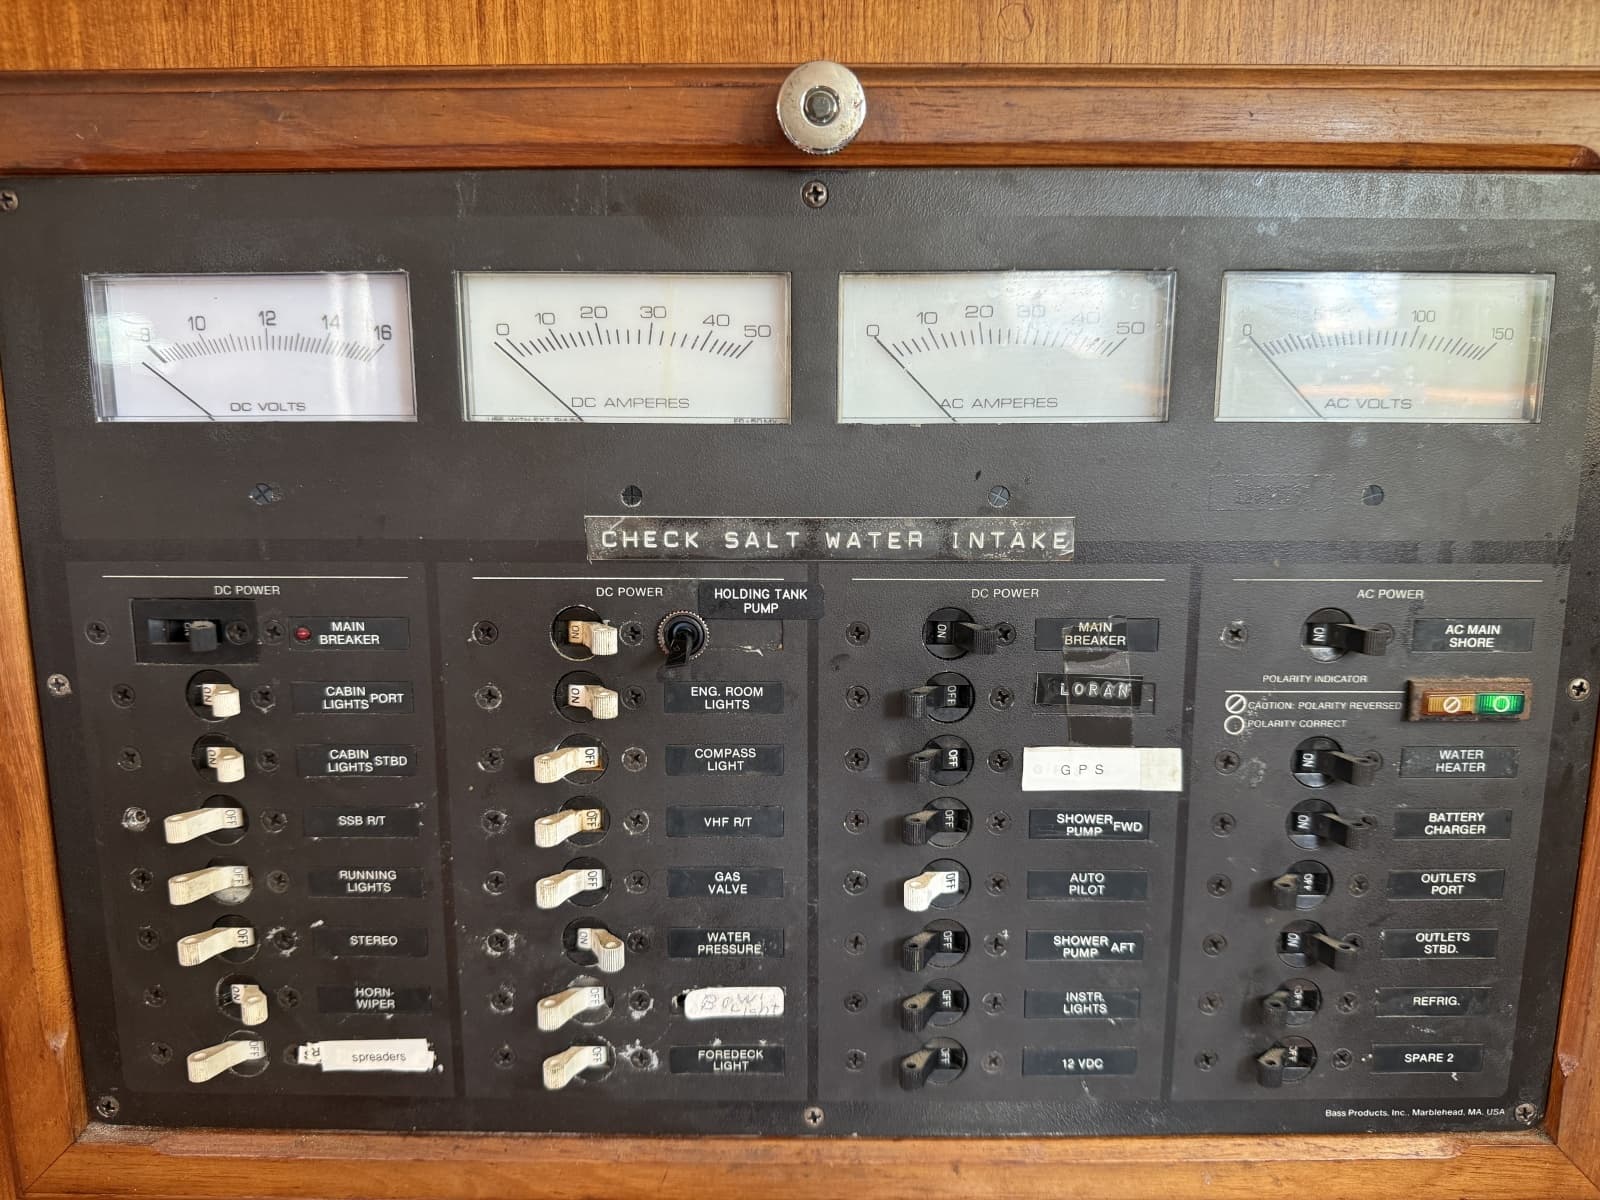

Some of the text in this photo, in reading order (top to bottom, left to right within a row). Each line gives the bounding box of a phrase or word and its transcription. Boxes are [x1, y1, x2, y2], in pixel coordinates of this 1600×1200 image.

[580, 306, 608, 319] 20
[640, 306, 667, 319] 30
[965, 305, 994, 319] 20
[1017, 304, 1046, 318] 30
[1411, 310, 1436, 323] 100
[187, 315, 206, 331] 10
[258, 310, 277, 326] 12
[322, 314, 340, 331] 14
[535, 312, 556, 325] 10
[702, 314, 730, 327] 40
[916, 311, 938, 324] 10
[1071, 311, 1101, 325] 40
[374, 324, 392, 341] 16
[496, 323, 510, 336] 0
[743, 325, 771, 338] 50
[866, 325, 880, 337] 0
[1116, 321, 1145, 335] 50
[1242, 323, 1252, 337] 0
[1491, 327, 1514, 341] 150
[230, 402, 306, 412] DC VOLTS
[571, 397, 690, 409] DC AMPERES
[940, 398, 1058, 409] AC AMPERES
[1324, 398, 1412, 409] AC VOLTS
[601, 530, 1069, 549] CHECK SALT WATER INTAKE
[214, 585, 281, 596] DC POWER
[596, 587, 663, 597] DC POWER
[714, 588, 808, 600] HOLDING TANK
[971, 588, 1039, 599] DC POWER
[1356, 589, 1424, 599] AC POWER
[744, 603, 779, 615] PUMP
[332, 622, 365, 632] MAIN
[937, 624, 947, 639] ON
[1079, 623, 1112, 633] MAIN
[1444, 625, 1501, 635] AC MAIN
[320, 635, 380, 645] BREAKER
[1313, 627, 1326, 642] ON
[1064, 635, 1126, 646] BREAKER
[1449, 638, 1495, 648] SHORE
[1262, 675, 1368, 683] POLARITY INDICATOR
[203, 687, 212, 703] ON
[326, 687, 366, 697] CABIN
[571, 687, 580, 704] ON
[691, 686, 763, 697] ENG. ROOM
[947, 685, 957, 706] OFF
[1060, 683, 1131, 698] LORAN
[370, 693, 404, 704] PORT
[323, 699, 370, 710] LIGHTS
[704, 699, 750, 710] LIGHTS
[1248, 702, 1402, 710] CAUTION: POLARITY REVERSED
[1248, 720, 1348, 728] POLARITY CORRECT
[208, 749, 217, 765] ON
[330, 750, 369, 760] CABIN
[585, 748, 596, 765] OFF
[695, 748, 756, 759] COMPASS
[948, 749, 958, 768] OFF
[1439, 750, 1484, 760] WATER
[374, 756, 408, 766] STBD
[707, 760, 745, 771] LIGHT
[1302, 753, 1315, 768] ON
[328, 762, 374, 772] LIGHTS
[1435, 762, 1486, 773] HEATER
[225, 809, 237, 825] OFF
[338, 816, 386, 826] SSB R/T
[586, 810, 598, 827] OFF
[704, 816, 753, 828] VHF R/T
[945, 809, 954, 828] OFF
[1056, 814, 1113, 825] SHOWER
[1297, 814, 1310, 830] ON
[1429, 812, 1485, 823] BATTERY
[1066, 827, 1103, 837] PUMP
[1113, 821, 1142, 832] FWD
[1424, 824, 1486, 835] CHARGER
[339, 870, 397, 880] RUNNING
[587, 870, 598, 887] OFF
[715, 872, 741, 883] GAS
[1070, 872, 1105, 883] AUTO
[1421, 872, 1477, 883] OUTLETS
[945, 872, 956, 890] OFF
[348, 882, 392, 893] LIGHTS
[708, 884, 748, 895] VALVE
[1069, 885, 1105, 895] PILOT
[1431, 885, 1464, 895] PORT
[237, 928, 248, 945] OFF
[350, 936, 398, 946] STEREO
[579, 931, 588, 945] ON
[707, 932, 750, 943] WATER
[943, 930, 953, 950] OFF
[1053, 935, 1109, 947] SHOWER
[1287, 932, 1299, 948] ON
[1416, 932, 1471, 943] OUTLETS
[698, 944, 761, 955] PRESSURE
[1063, 948, 1099, 958] PUMP
[1111, 942, 1136, 953] AFT
[1424, 944, 1459, 954] STBD.
[232, 986, 240, 1001] ON
[942, 989, 952, 1008] OFF
[1066, 992, 1104, 1002] INSTR.
[356, 999, 395, 1009] WIPER
[1413, 997, 1460, 1006] REFRIG.
[1063, 1003, 1107, 1014] LIGHTS
[352, 1052, 407, 1063] spreaders
[698, 1050, 763, 1061] FOREDECK
[1404, 1053, 1454, 1063] SPARE 2
[713, 1061, 749, 1071] LIGHT
[1062, 1059, 1104, 1069] 12 VDC
[1325, 1109, 1347, 1117] Bass
[1412, 1108, 1466, 1118] Marblehead,
[1486, 1108, 1505, 1116] USA
